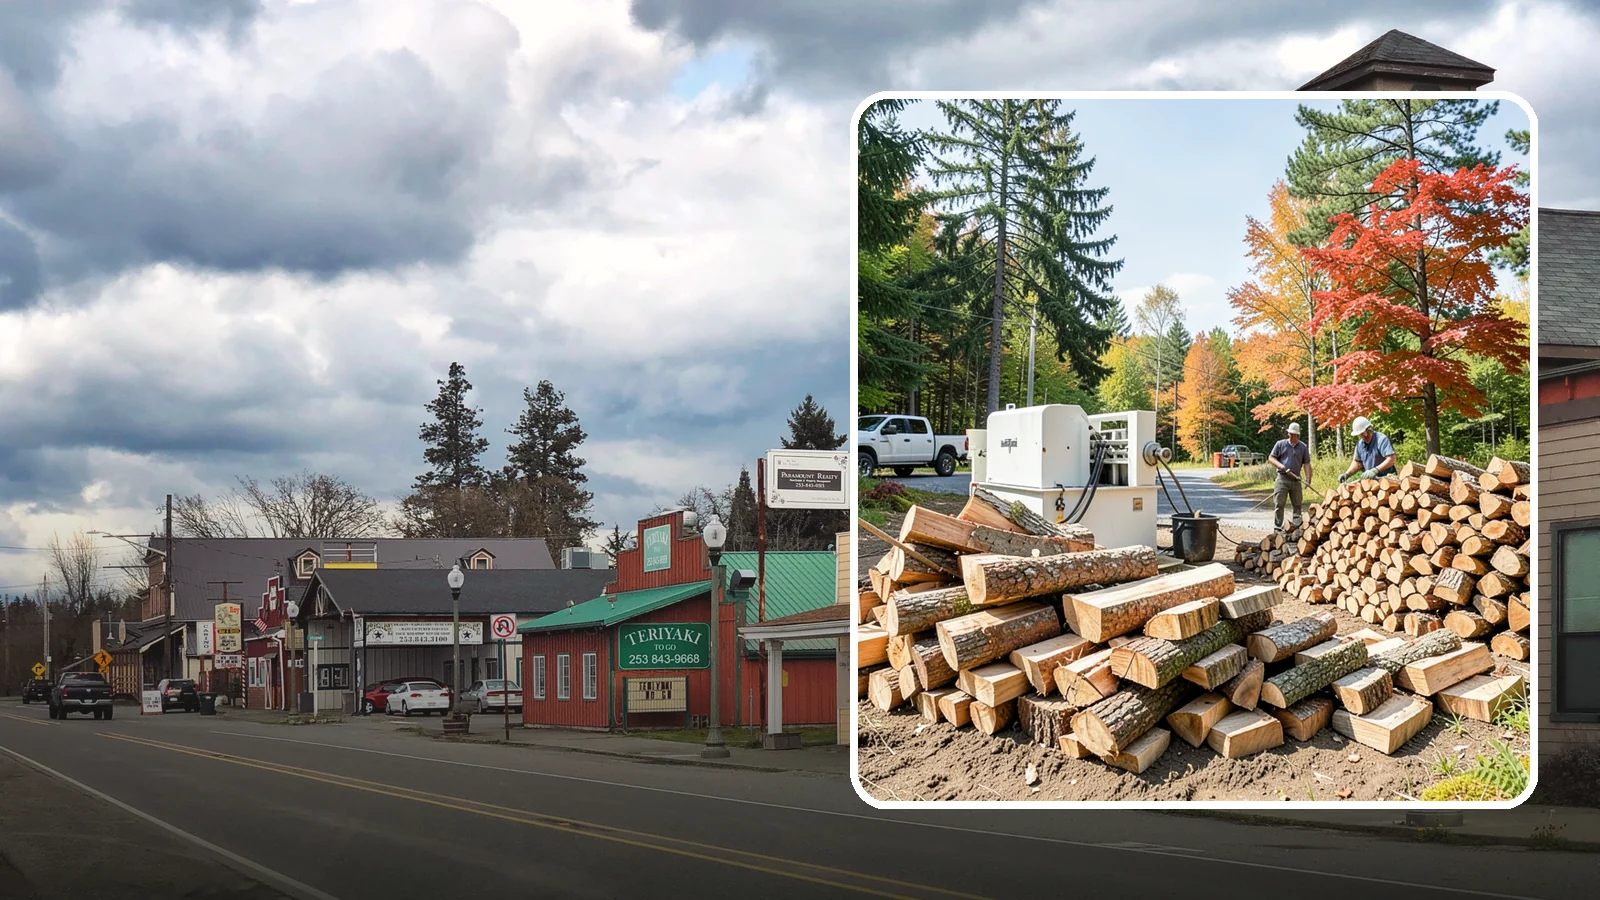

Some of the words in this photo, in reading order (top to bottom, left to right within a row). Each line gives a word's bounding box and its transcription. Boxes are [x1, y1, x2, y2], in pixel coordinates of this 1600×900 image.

[781, 471, 815, 479] PARAMOUNT
[817, 472, 839, 480] REALTY
[624, 627, 703, 646] TERIYAKI
[653, 643, 664, 651] TO
[665, 643, 677, 651] GO
[628, 654, 648, 665] 253
[651, 653, 700, 664] 843-9668
